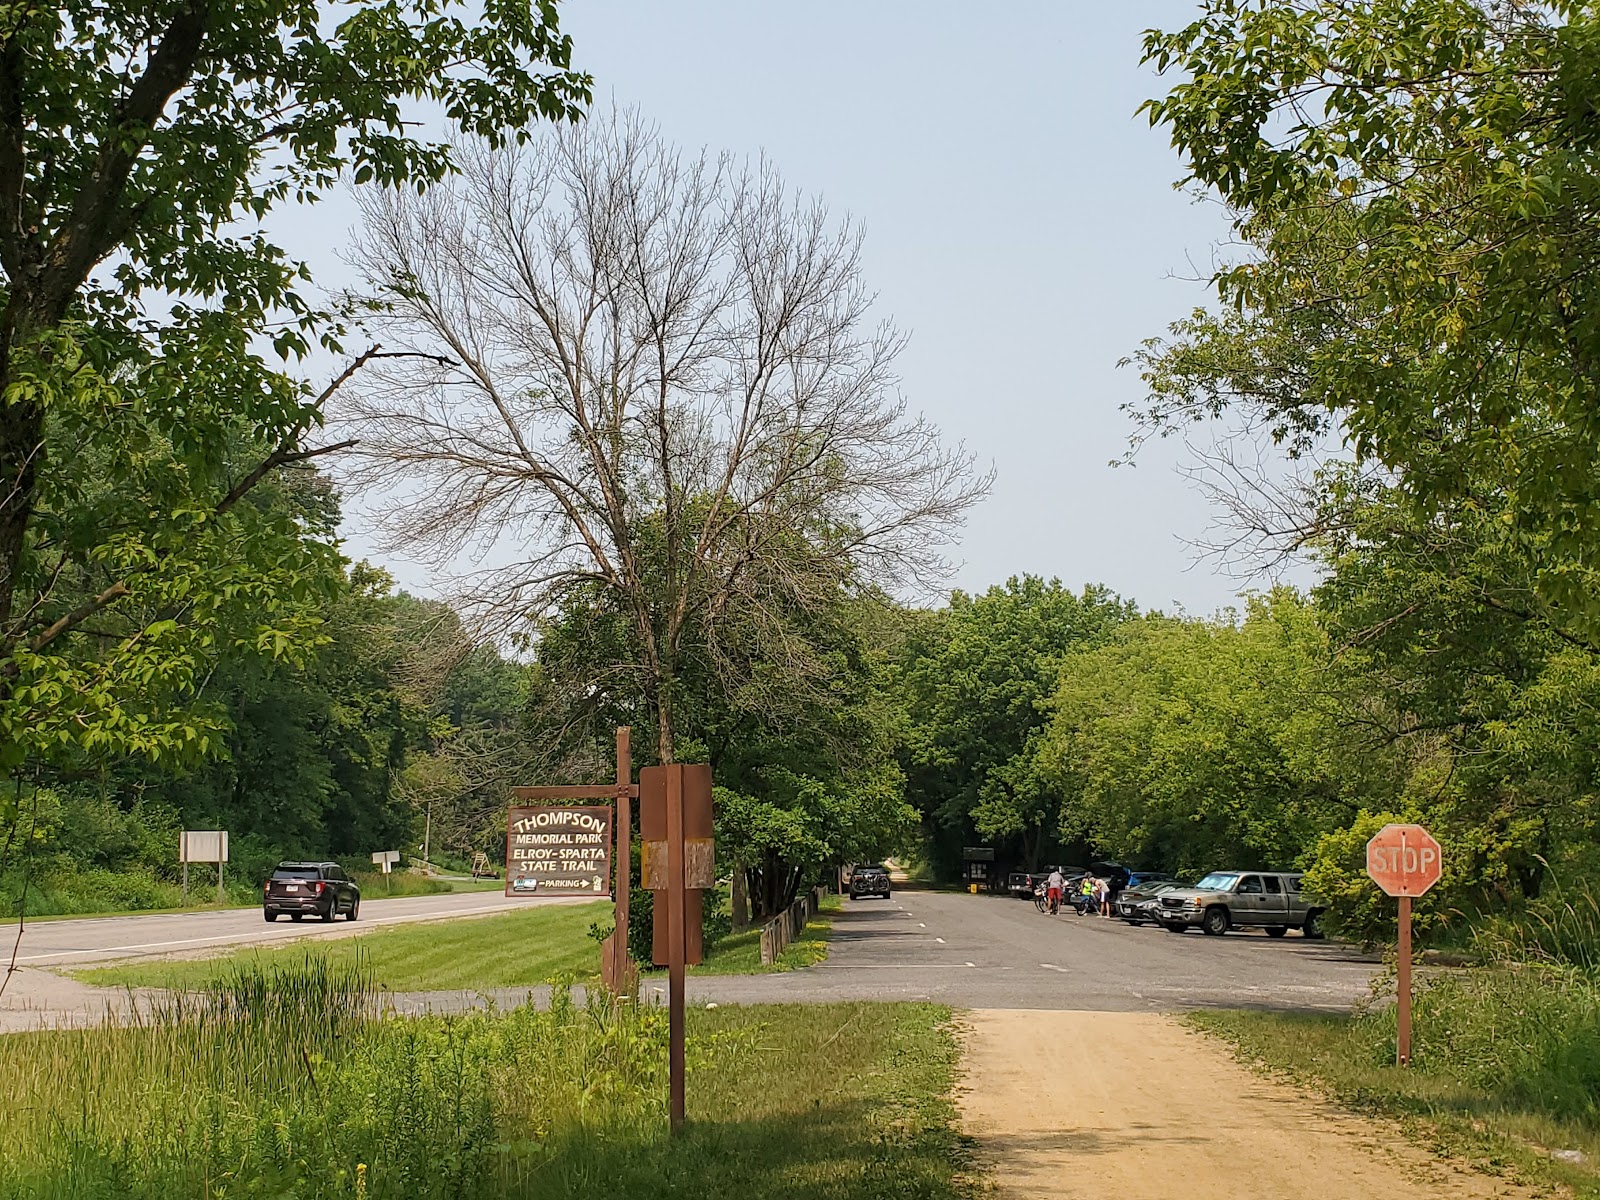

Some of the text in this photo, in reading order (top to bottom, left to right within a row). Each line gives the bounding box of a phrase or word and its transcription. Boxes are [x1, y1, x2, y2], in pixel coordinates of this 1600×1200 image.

[513, 812, 606, 834] THOMPSON
[516, 833, 603, 844] MEMORIAL PARK
[513, 848, 606, 859] ELROY-SPARTA
[1373, 846, 1436, 874] STOP
[520, 861, 597, 872] STATE TRAIL
[545, 879, 580, 888] PARKING
